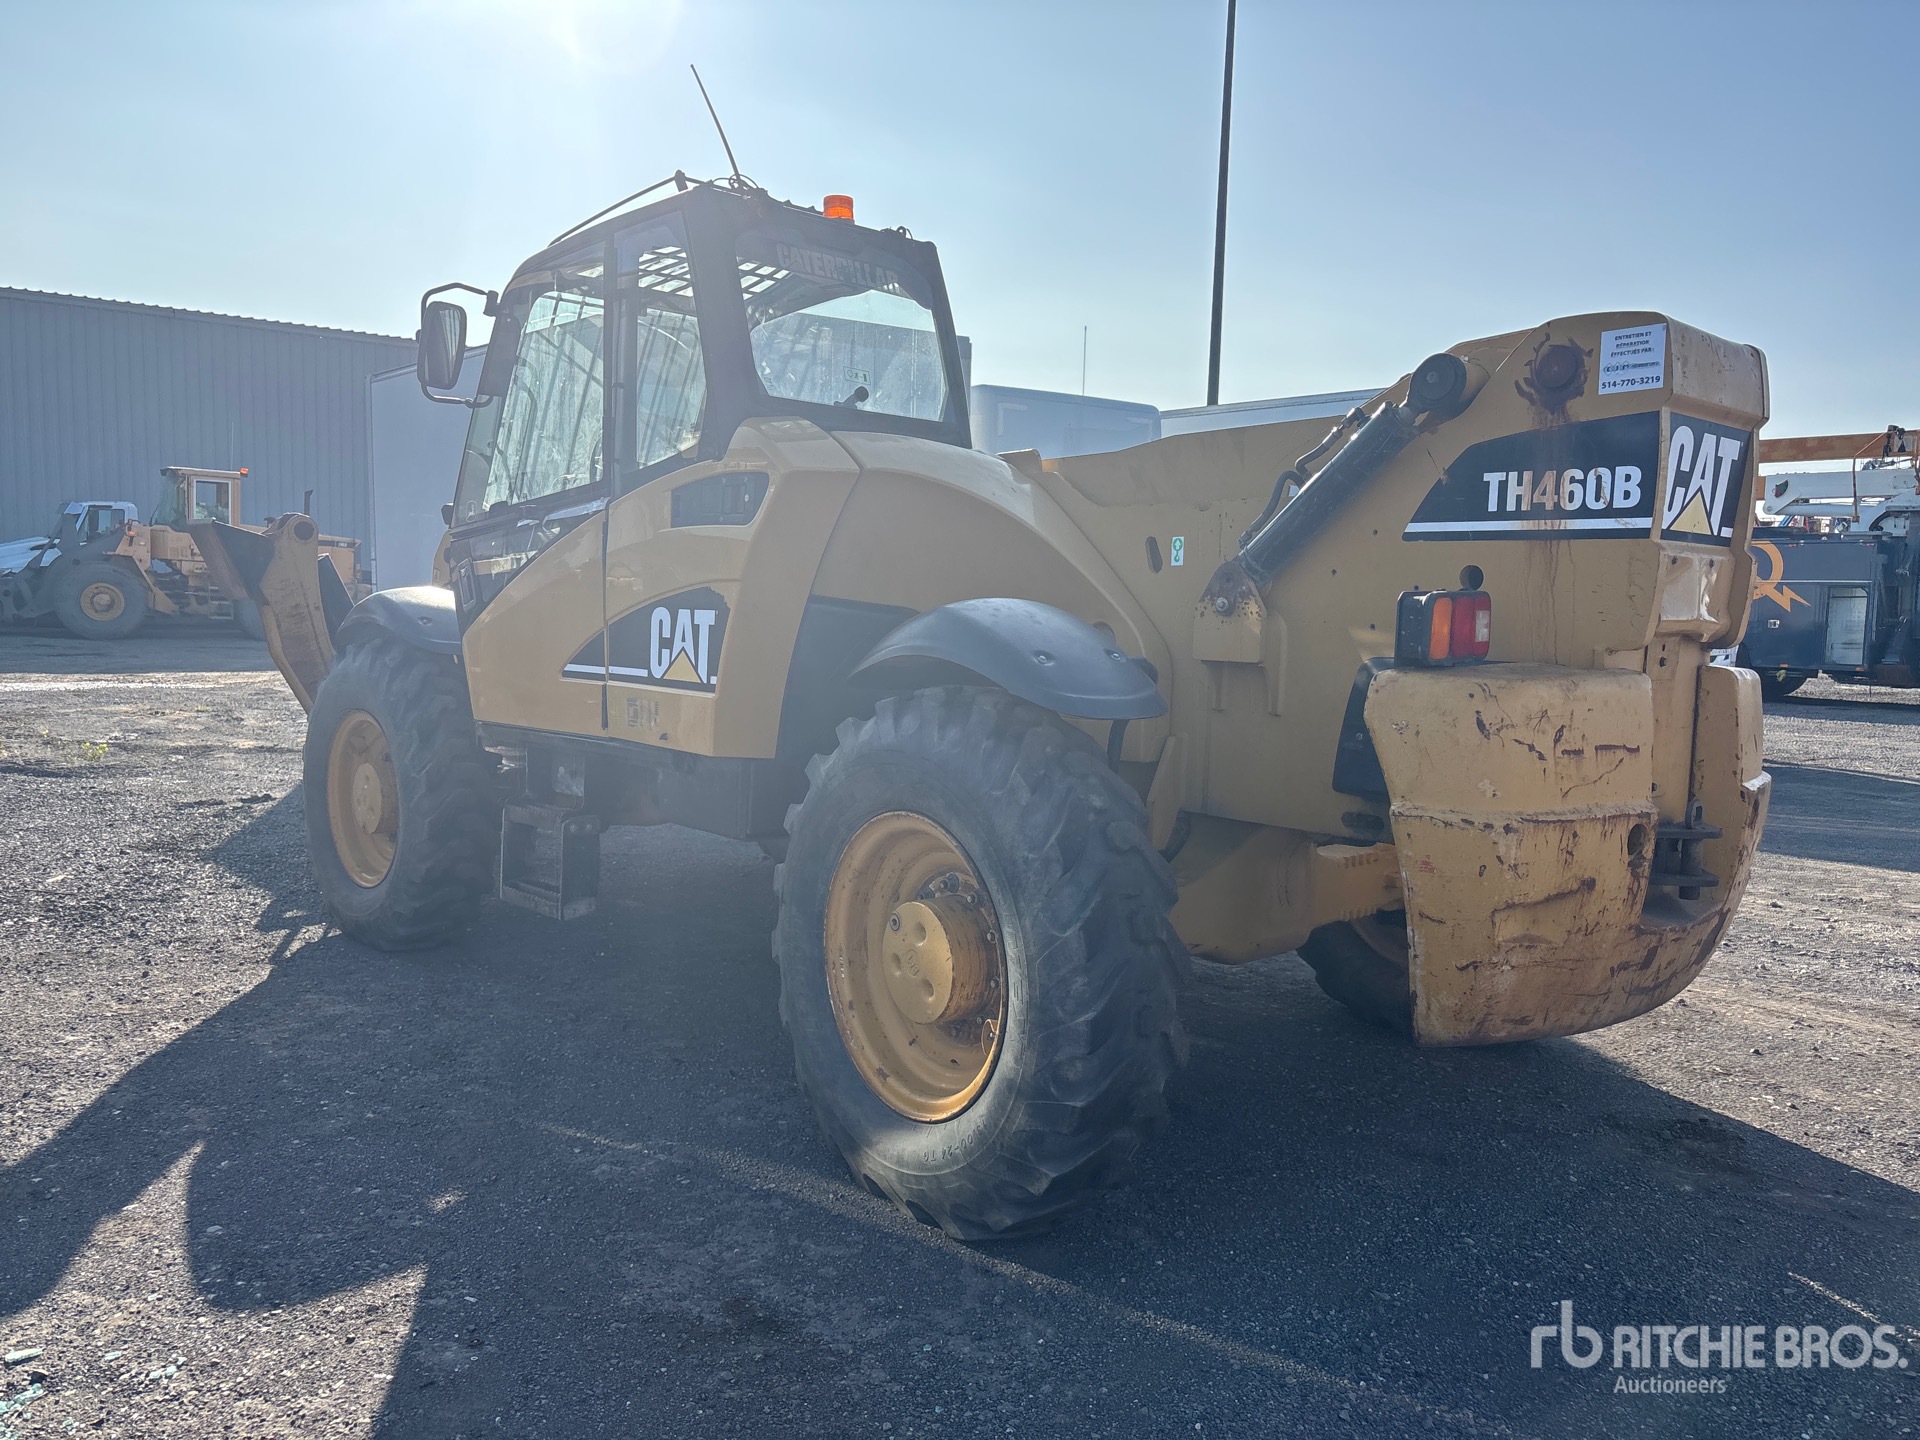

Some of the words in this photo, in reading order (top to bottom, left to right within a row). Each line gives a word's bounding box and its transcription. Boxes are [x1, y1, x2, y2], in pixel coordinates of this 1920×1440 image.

[1614, 332, 1645, 341] ENTRETIEN
[1601, 375, 1661, 390] 514-770-3219
[1483, 466, 1642, 512] TH460B
[1662, 425, 1740, 536] CAT
[650, 606, 716, 684] CAT
